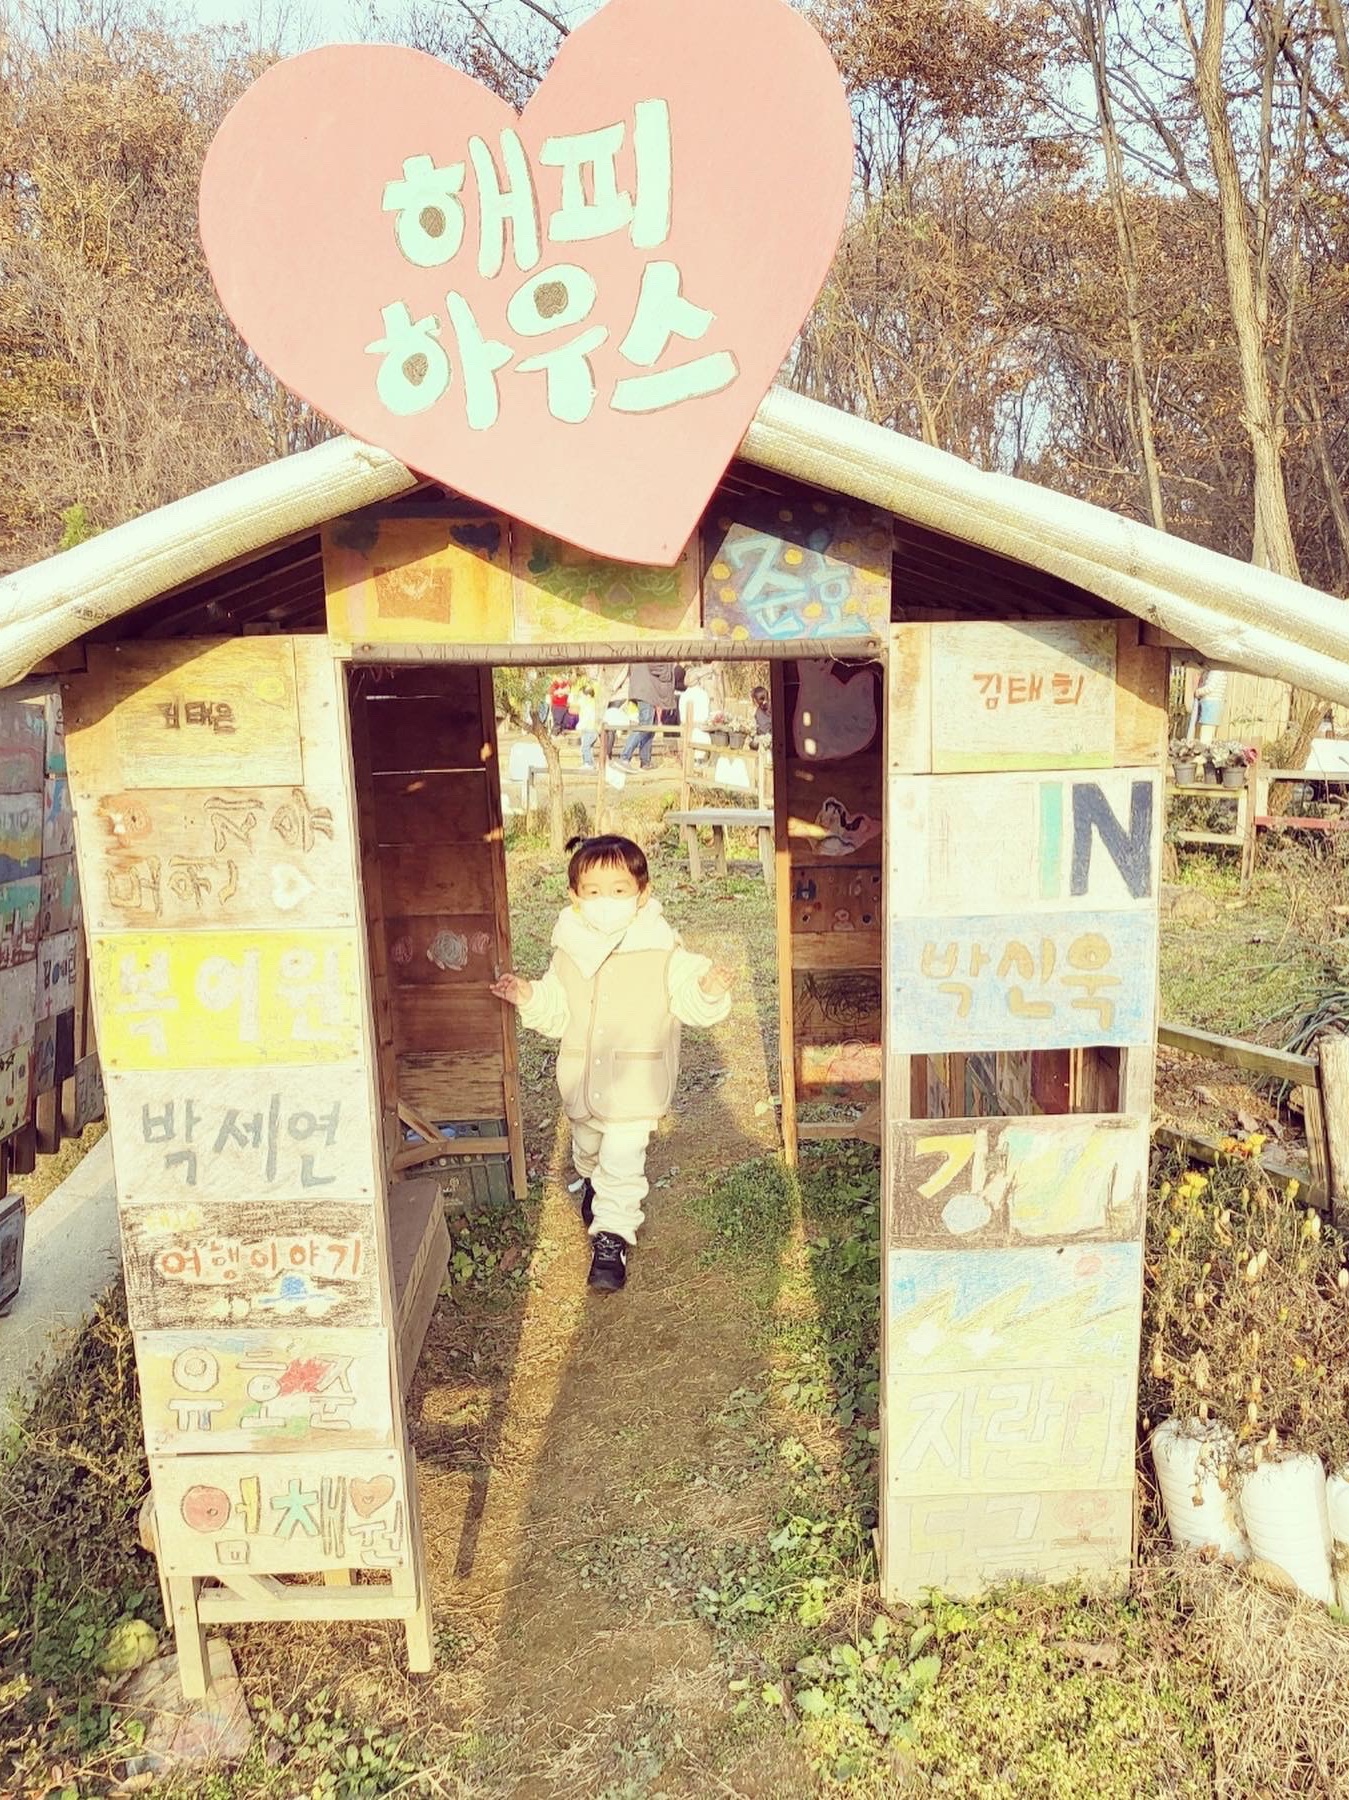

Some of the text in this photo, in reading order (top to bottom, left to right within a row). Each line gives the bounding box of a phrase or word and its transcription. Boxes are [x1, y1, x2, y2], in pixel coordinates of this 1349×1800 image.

[382, 98, 673, 279] 해피
[364, 260, 740, 431] 하우스
[972, 672, 1084, 710] 김태희
[921, 933, 1121, 1031] 박신욱
[142, 1093, 340, 1187] 박세연
[161, 1239, 361, 1280] 여행이야기
[180, 1474, 403, 1568] 엄채원
